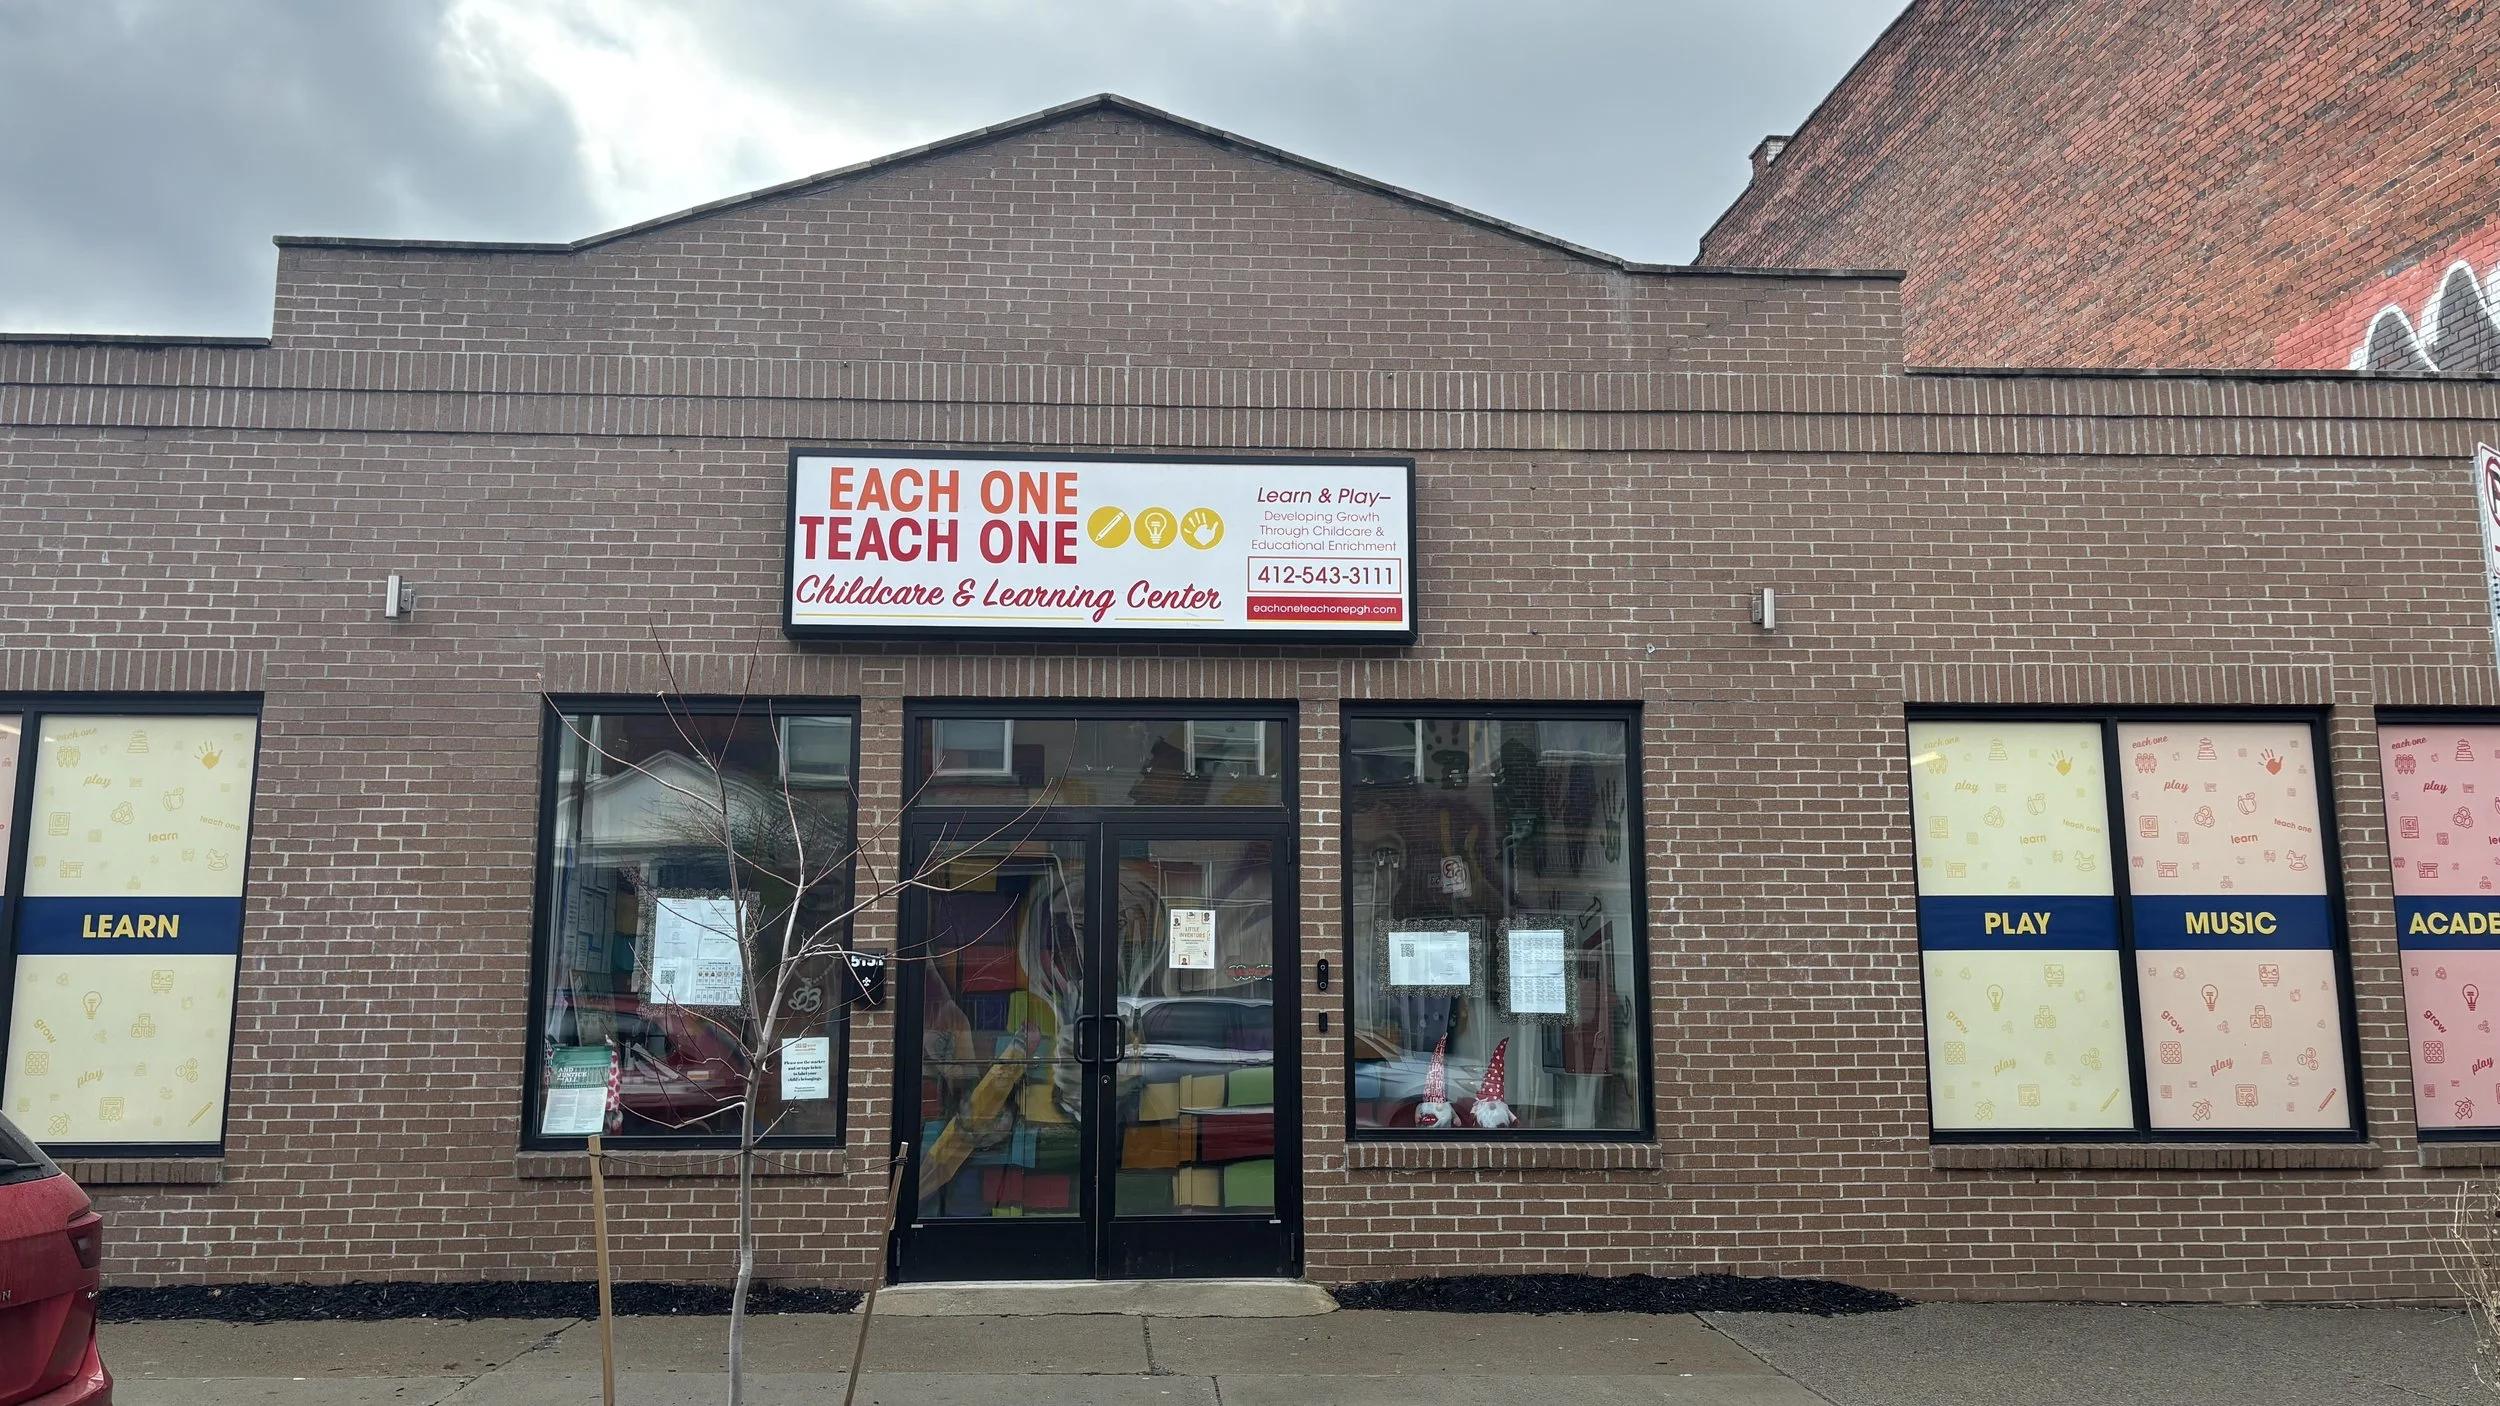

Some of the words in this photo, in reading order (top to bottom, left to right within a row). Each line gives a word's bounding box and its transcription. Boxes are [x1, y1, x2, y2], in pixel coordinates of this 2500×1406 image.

[829, 466, 960, 513] EACH
[979, 470, 1078, 515] ONE
[1257, 486, 1312, 504] Learn
[1318, 487, 1333, 504] &
[1263, 510, 1334, 524] Developing
[1336, 511, 1380, 523] Growth
[799, 515, 958, 563] TEACH
[979, 519, 1078, 565] ONE
[1259, 524, 1309, 538] Through
[1312, 525, 1372, 538] Childcare
[1375, 526, 1386, 538] &
[1251, 539, 1325, 551] Educational
[1328, 540, 1397, 552] Enrichment
[1257, 565, 1392, 585] 412-543-3111
[795, 574, 945, 606] Childcare
[952, 578, 977, 608] &
[982, 578, 1116, 624] Learning
[1126, 579, 1223, 610] Center
[1253, 604, 1397, 616] eachoneteachonepgh.com
[2131, 736, 2152, 750] each
[2152, 734, 2169, 746] one
[2391, 738, 2412, 750] each
[2411, 736, 2427, 746] one
[82, 773, 112, 789] play
[1954, 779, 1980, 794] play
[2163, 778, 2190, 794] play
[2422, 779, 2449, 795] play
[199, 815, 223, 828] teach
[224, 822, 241, 833] one
[2062, 818, 2085, 831] teach
[2085, 824, 2101, 834] one
[2273, 817, 2296, 831] teach
[2297, 824, 2313, 835] one
[148, 831, 179, 843] learn
[2019, 833, 2047, 845] learn
[2230, 832, 2259, 845] learn
[82, 914, 180, 939] LEARN
[1984, 911, 2051, 935] PLAY
[2184, 911, 2278, 935] MUSIC
[1946, 1010, 1970, 1035] grow
[2160, 1010, 2185, 1035] grow
[2423, 1009, 2448, 1034] grow
[33, 1018, 57, 1045] grow
[1993, 1057, 2017, 1077] play
[2210, 1057, 2234, 1077] play
[2471, 1056, 2495, 1076] play
[77, 1068, 105, 1089] play
